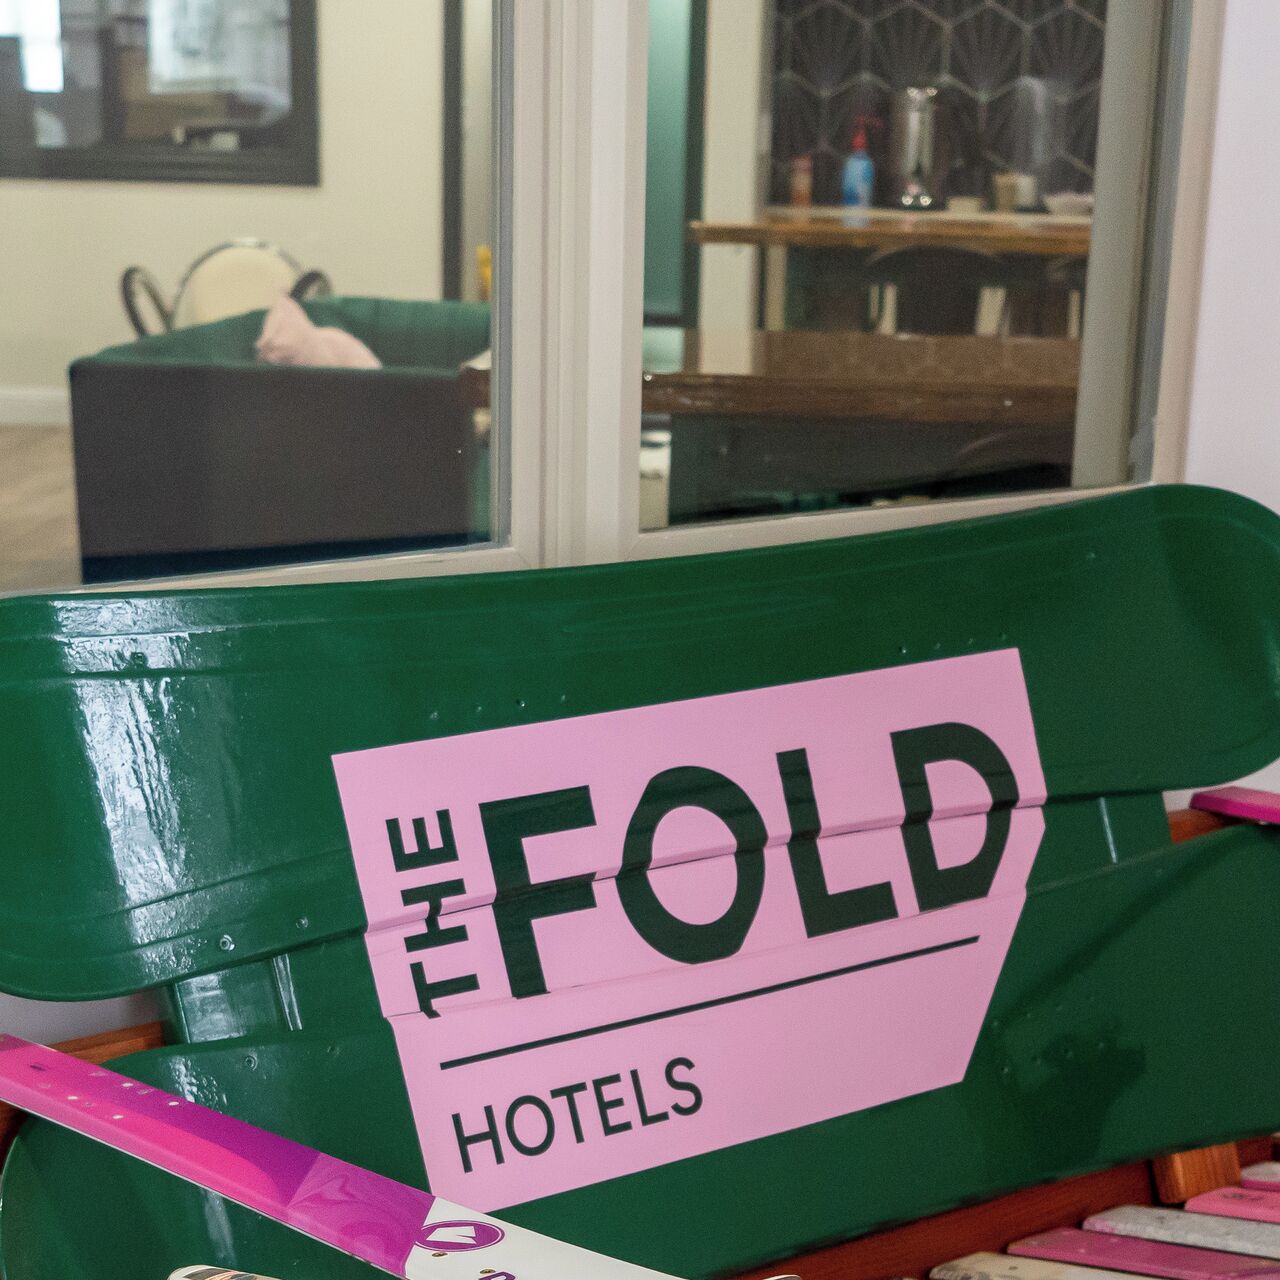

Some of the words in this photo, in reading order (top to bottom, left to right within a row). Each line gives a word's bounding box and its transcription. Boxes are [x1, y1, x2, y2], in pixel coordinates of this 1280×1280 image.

[385, 808, 481, 1020] THE
[477, 721, 1020, 1000] FOLD
[450, 1056, 704, 1175] HOTELS
